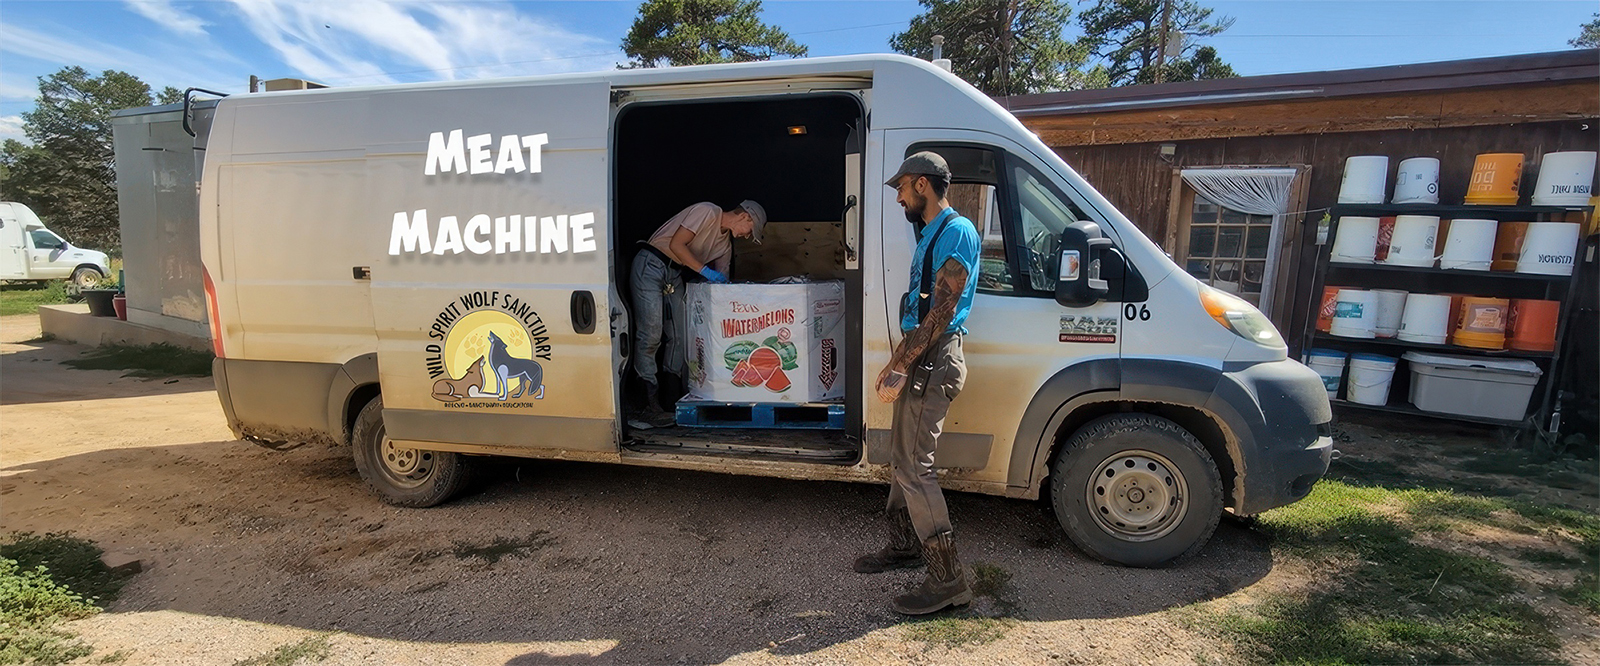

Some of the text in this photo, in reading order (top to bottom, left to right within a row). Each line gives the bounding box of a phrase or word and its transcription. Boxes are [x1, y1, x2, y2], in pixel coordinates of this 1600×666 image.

[720, 308, 795, 339] WATERMELONS
[1124, 303, 1151, 321] 06
[425, 291, 552, 379] WILD SPIRIT WOLF SANCTUARY
